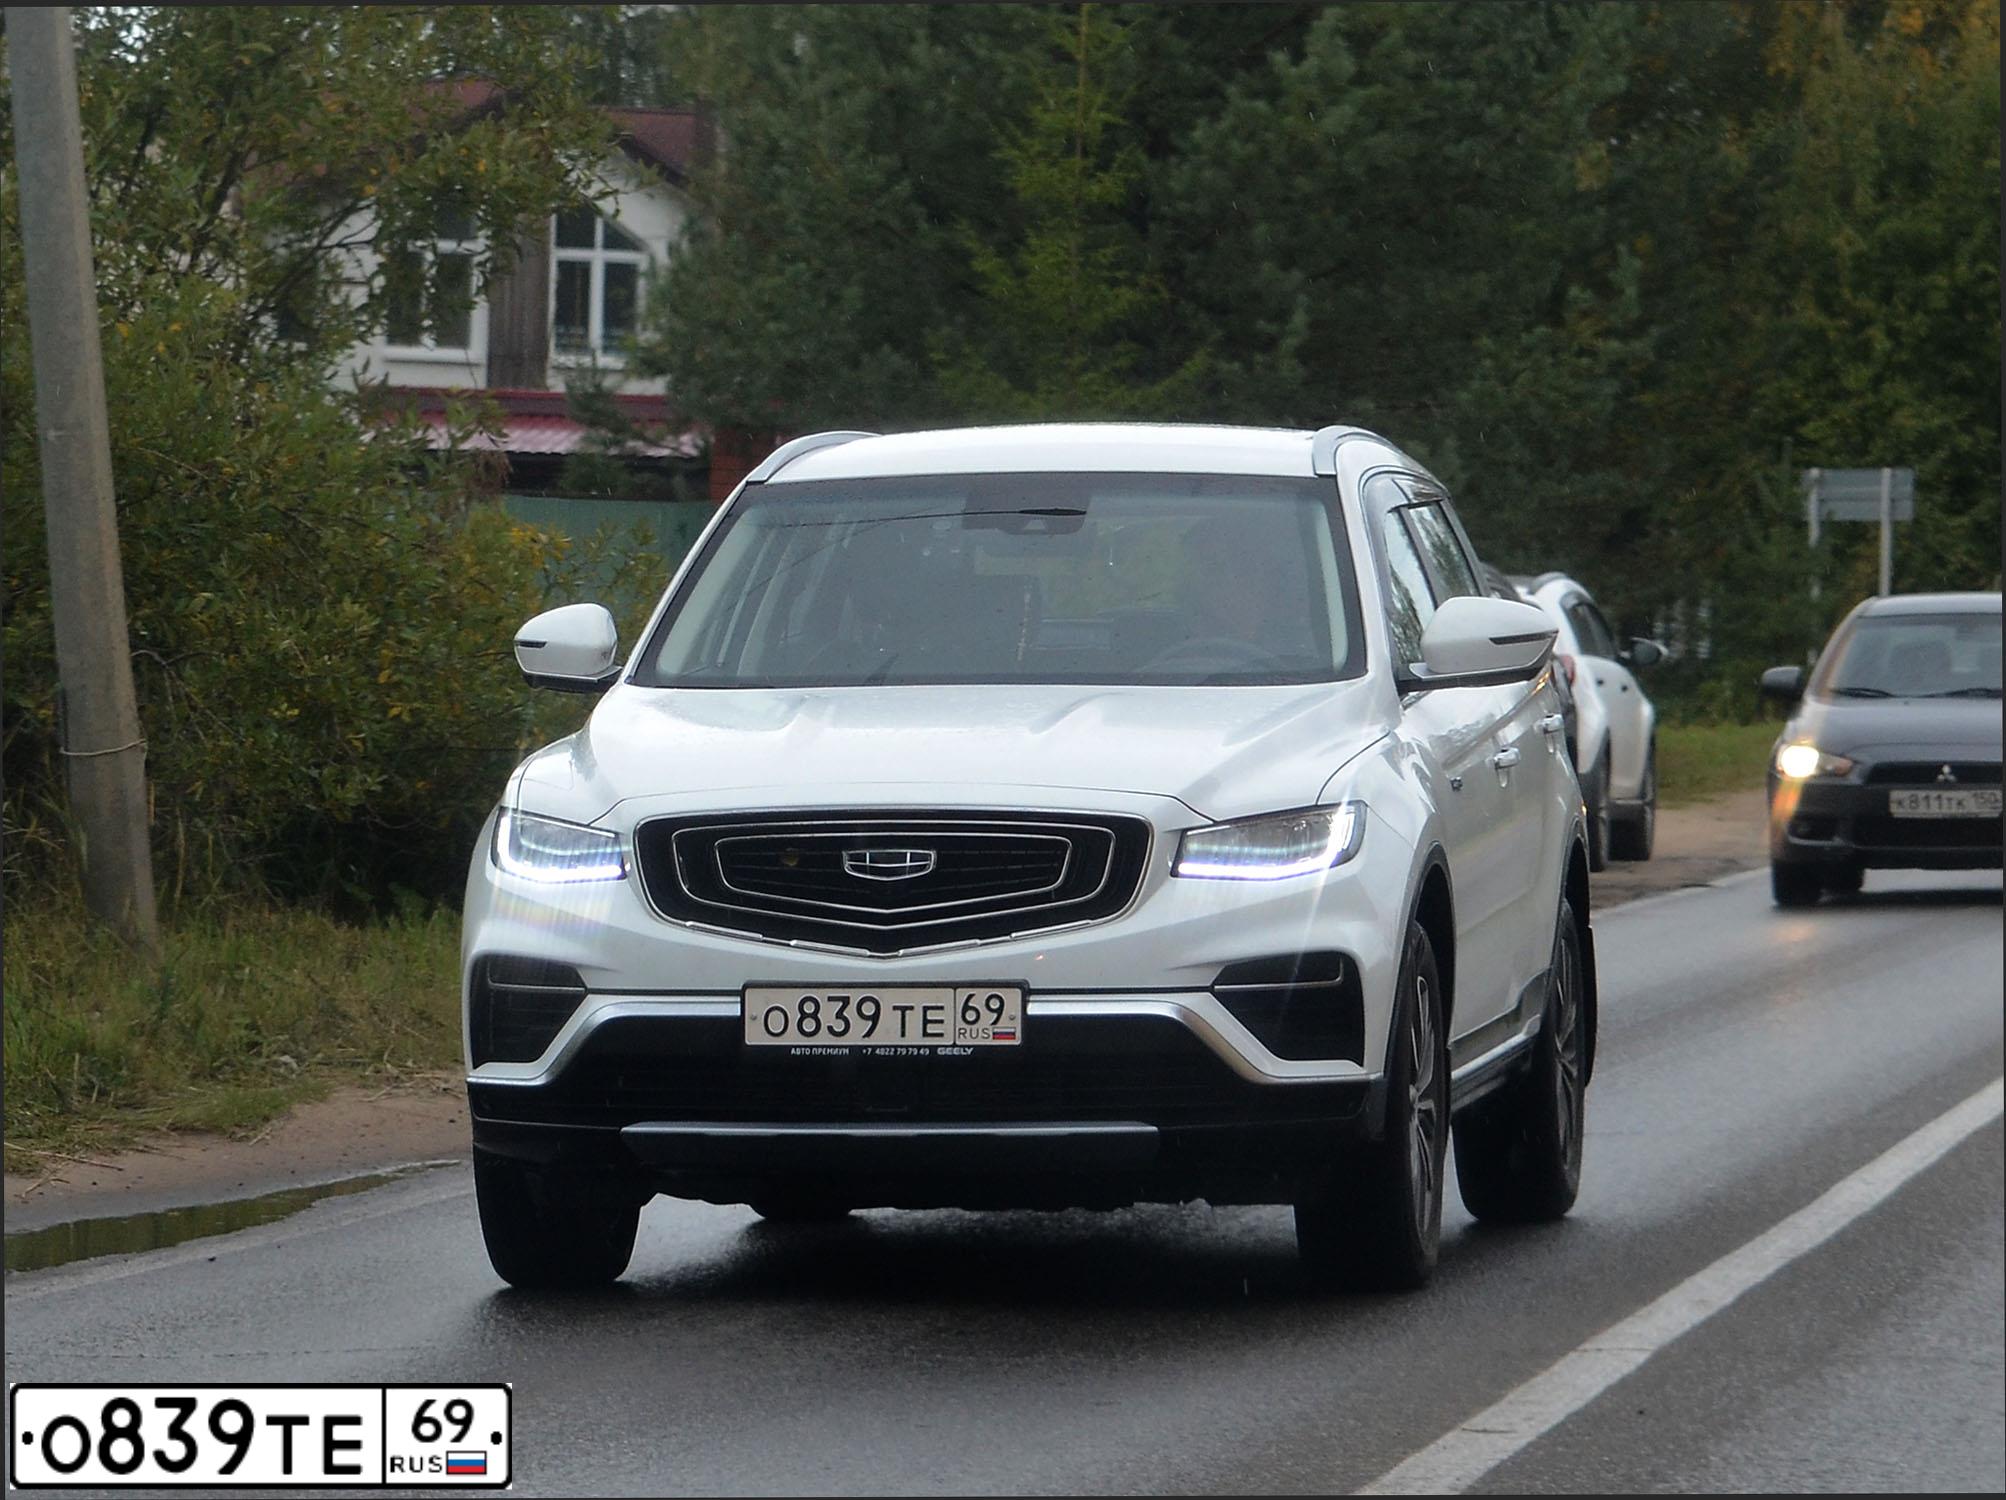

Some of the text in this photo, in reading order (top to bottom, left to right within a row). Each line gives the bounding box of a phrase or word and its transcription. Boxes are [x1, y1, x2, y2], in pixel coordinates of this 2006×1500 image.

[961, 993, 1005, 1026] 69
[957, 1027, 991, 1039] RUS
[790, 1047, 811, 1056] АВТО
[937, 1047, 974, 1056] GEELY
